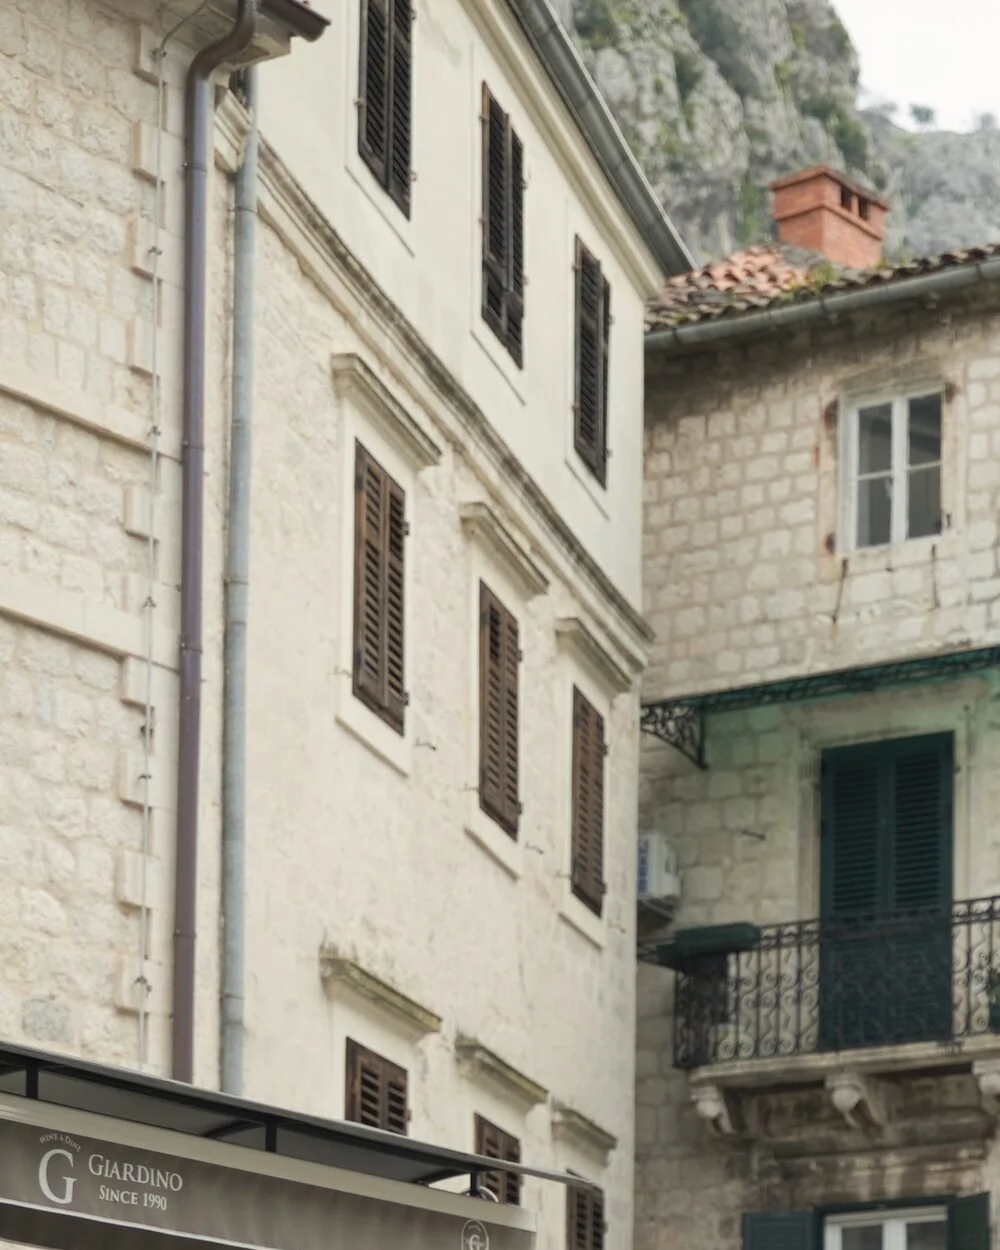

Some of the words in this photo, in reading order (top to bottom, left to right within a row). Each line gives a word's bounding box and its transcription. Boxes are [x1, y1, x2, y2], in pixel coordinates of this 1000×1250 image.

[38, 1149, 77, 1204] G
[88, 1153, 183, 1191] GIARDINO
[99, 1185, 138, 1205] SINCE
[143, 1193, 167, 1211] 1990
